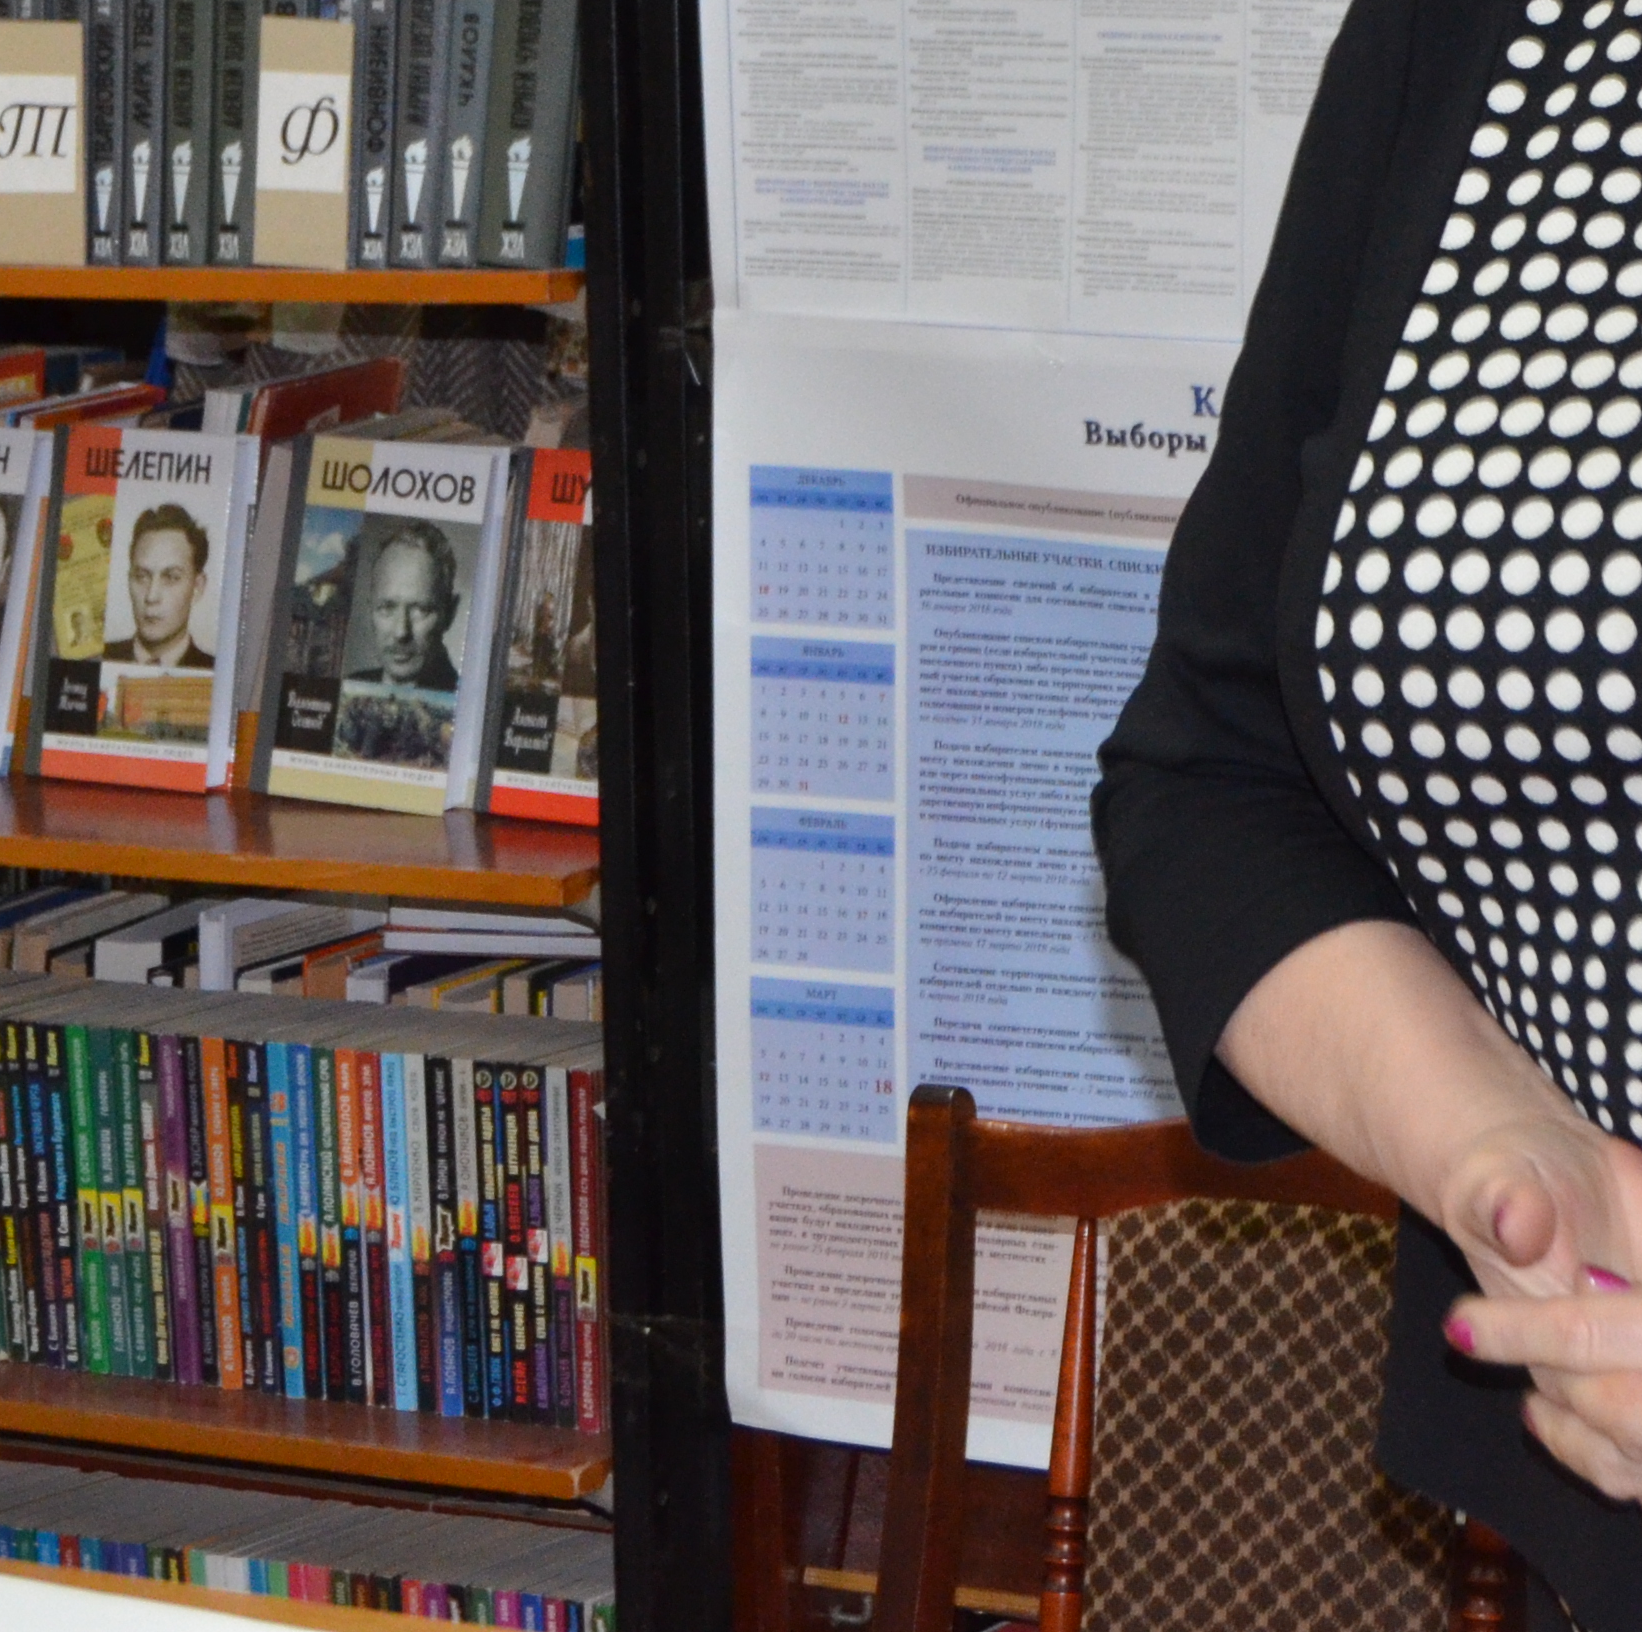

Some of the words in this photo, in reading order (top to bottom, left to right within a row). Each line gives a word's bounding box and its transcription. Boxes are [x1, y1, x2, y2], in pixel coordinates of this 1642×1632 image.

[457, 13, 480, 107] ЧКАЛОВ
[133, 62, 152, 129] МАРК
[366, 25, 388, 152] ФОНВИЗИН
[280, 97, 339, 164] Ф
[1085, 421, 1207, 458] Выборы
[84, 445, 211, 484] ШЕЛЕПИН
[321, 458, 476, 507] ШОЛОХОВ
[797, 475, 845, 486] ДЕКАБРЬ
[926, 544, 1039, 564] ИЗБИРАТЕЛЬНЫЕ
[802, 646, 844, 657] ЯНВАРЬ
[799, 818, 847, 829] ФЕВРАЛЬ
[806, 989, 838, 1000] МАРТ
[875, 1079, 893, 1095] 18
